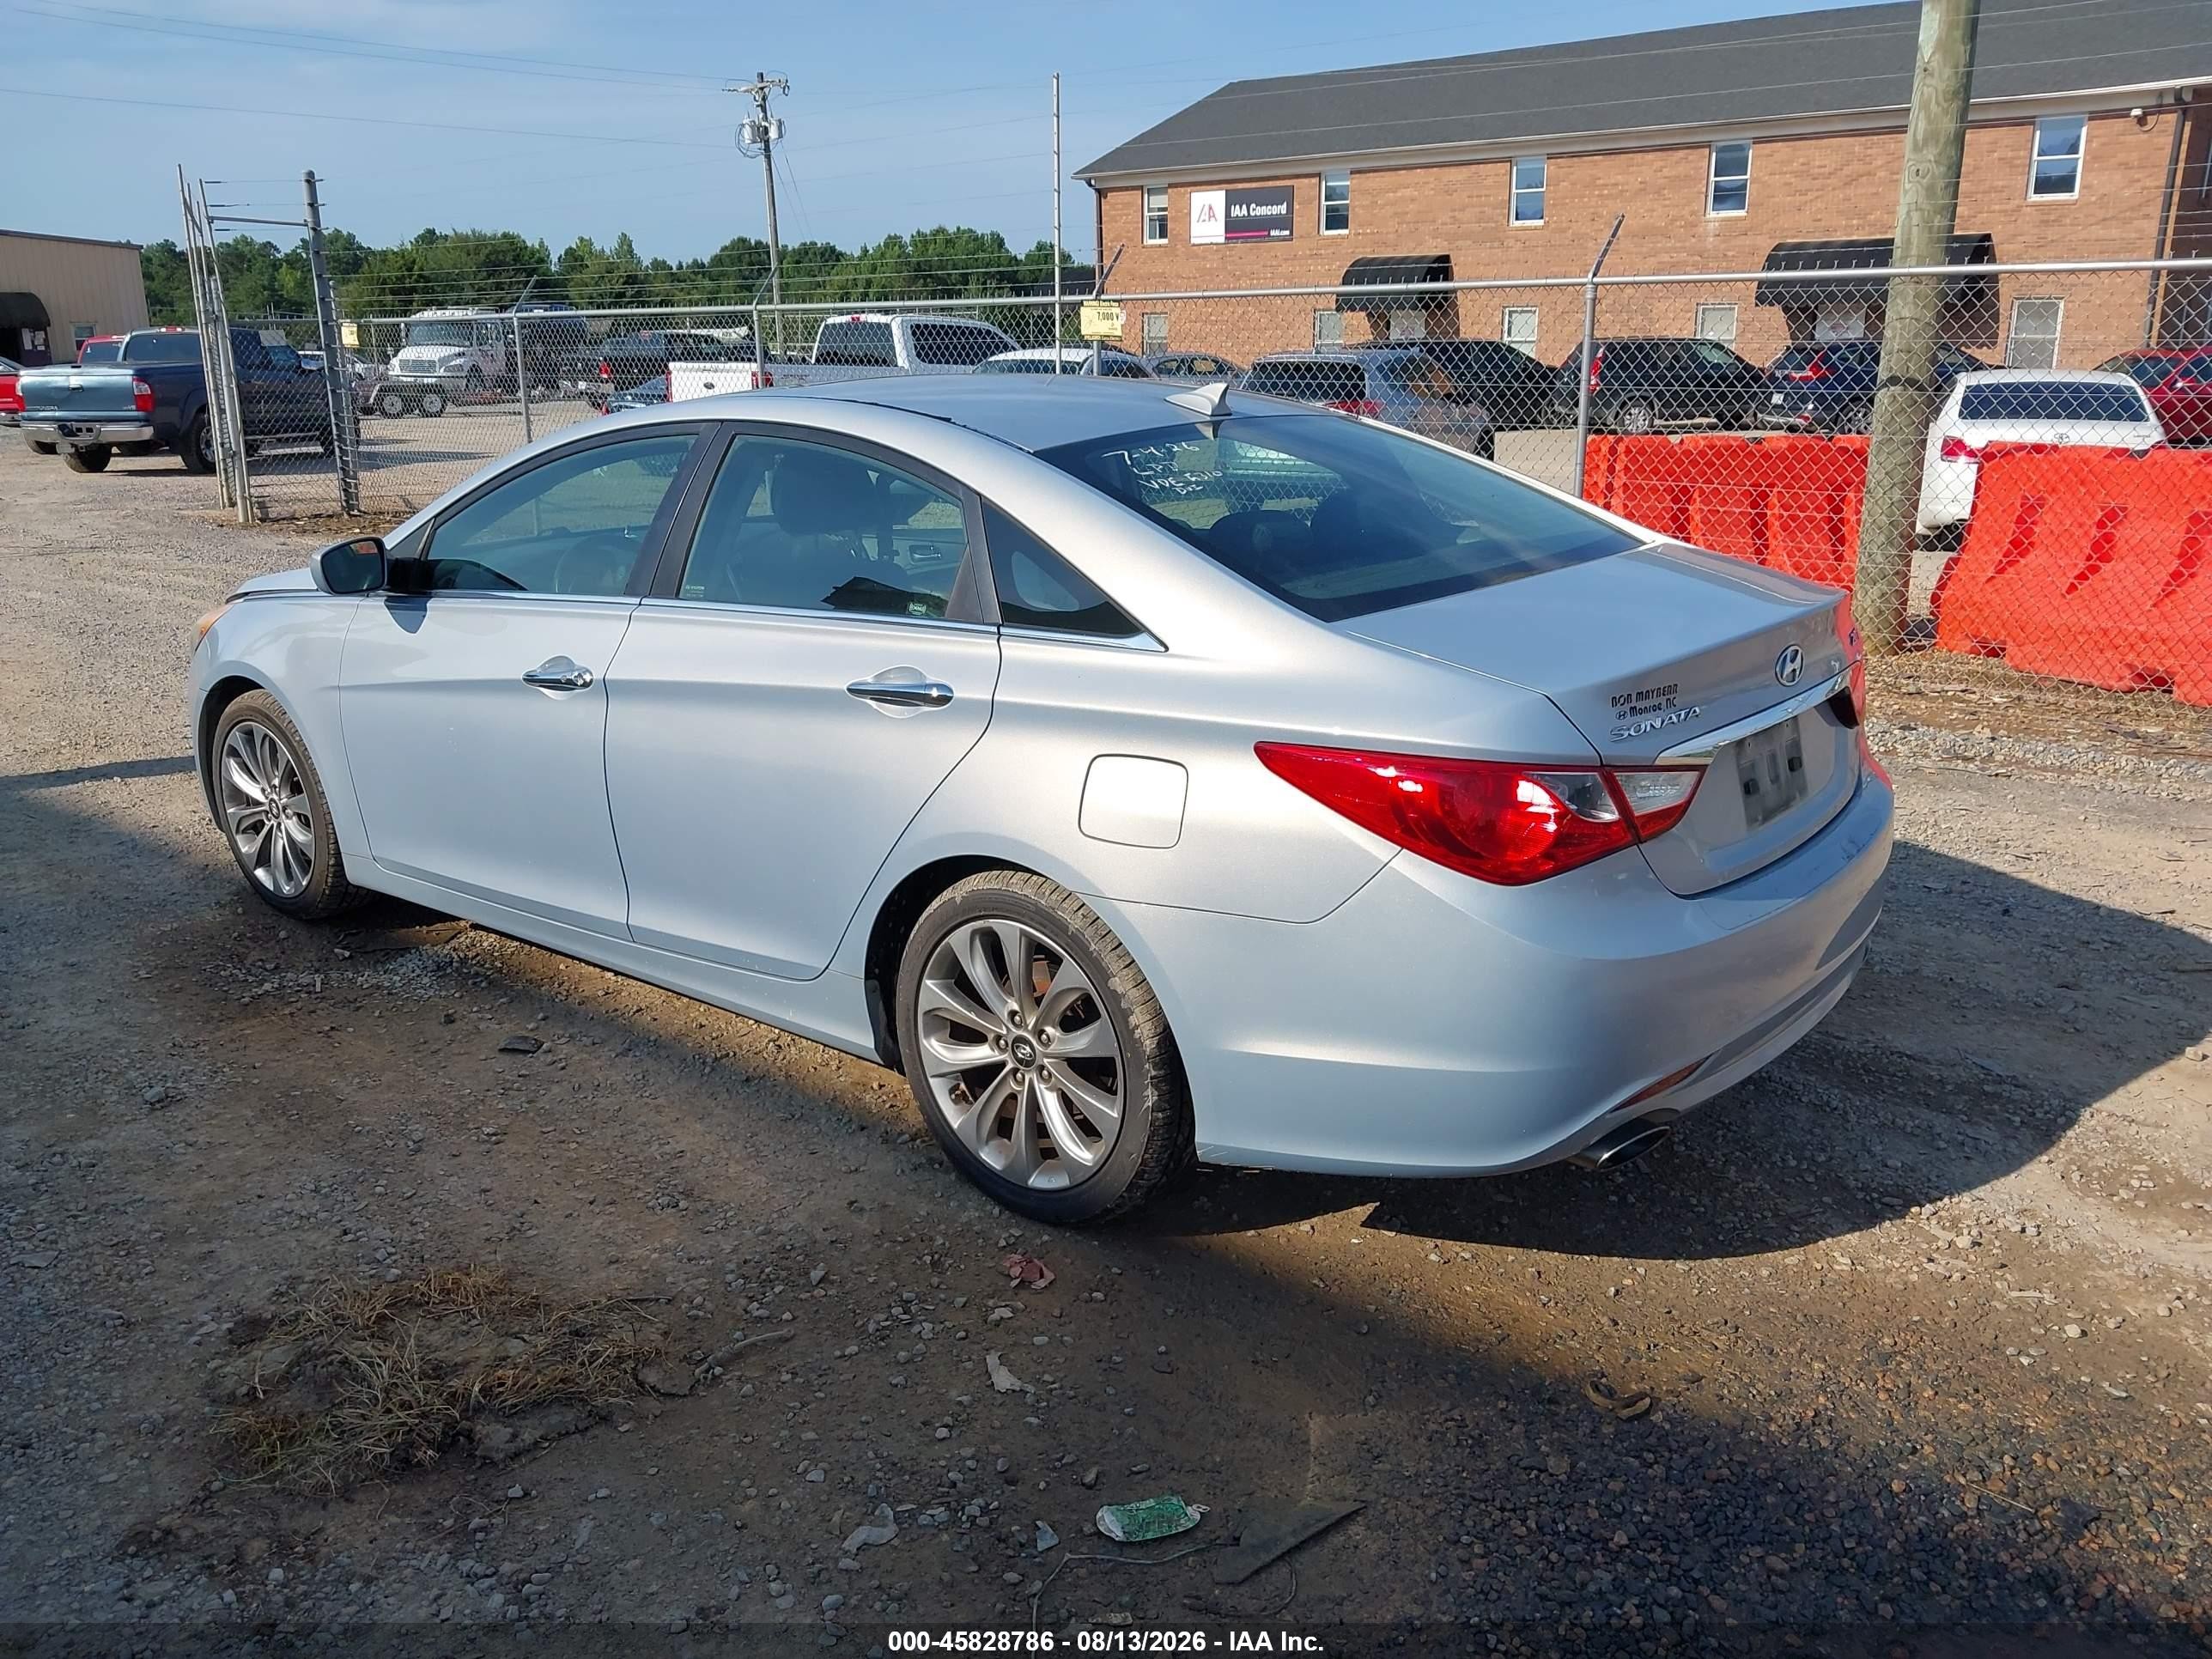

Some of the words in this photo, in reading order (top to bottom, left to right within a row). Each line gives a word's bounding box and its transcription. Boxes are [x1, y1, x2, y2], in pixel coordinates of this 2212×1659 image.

[1231, 204, 1248, 217] IAA
[1249, 199, 1287, 216] Concord
[1097, 312, 1115, 322] 7,000
[1611, 693, 1633, 708] BOB
[1666, 696, 1677, 710] NC
[1610, 706, 1701, 742] SONATA
